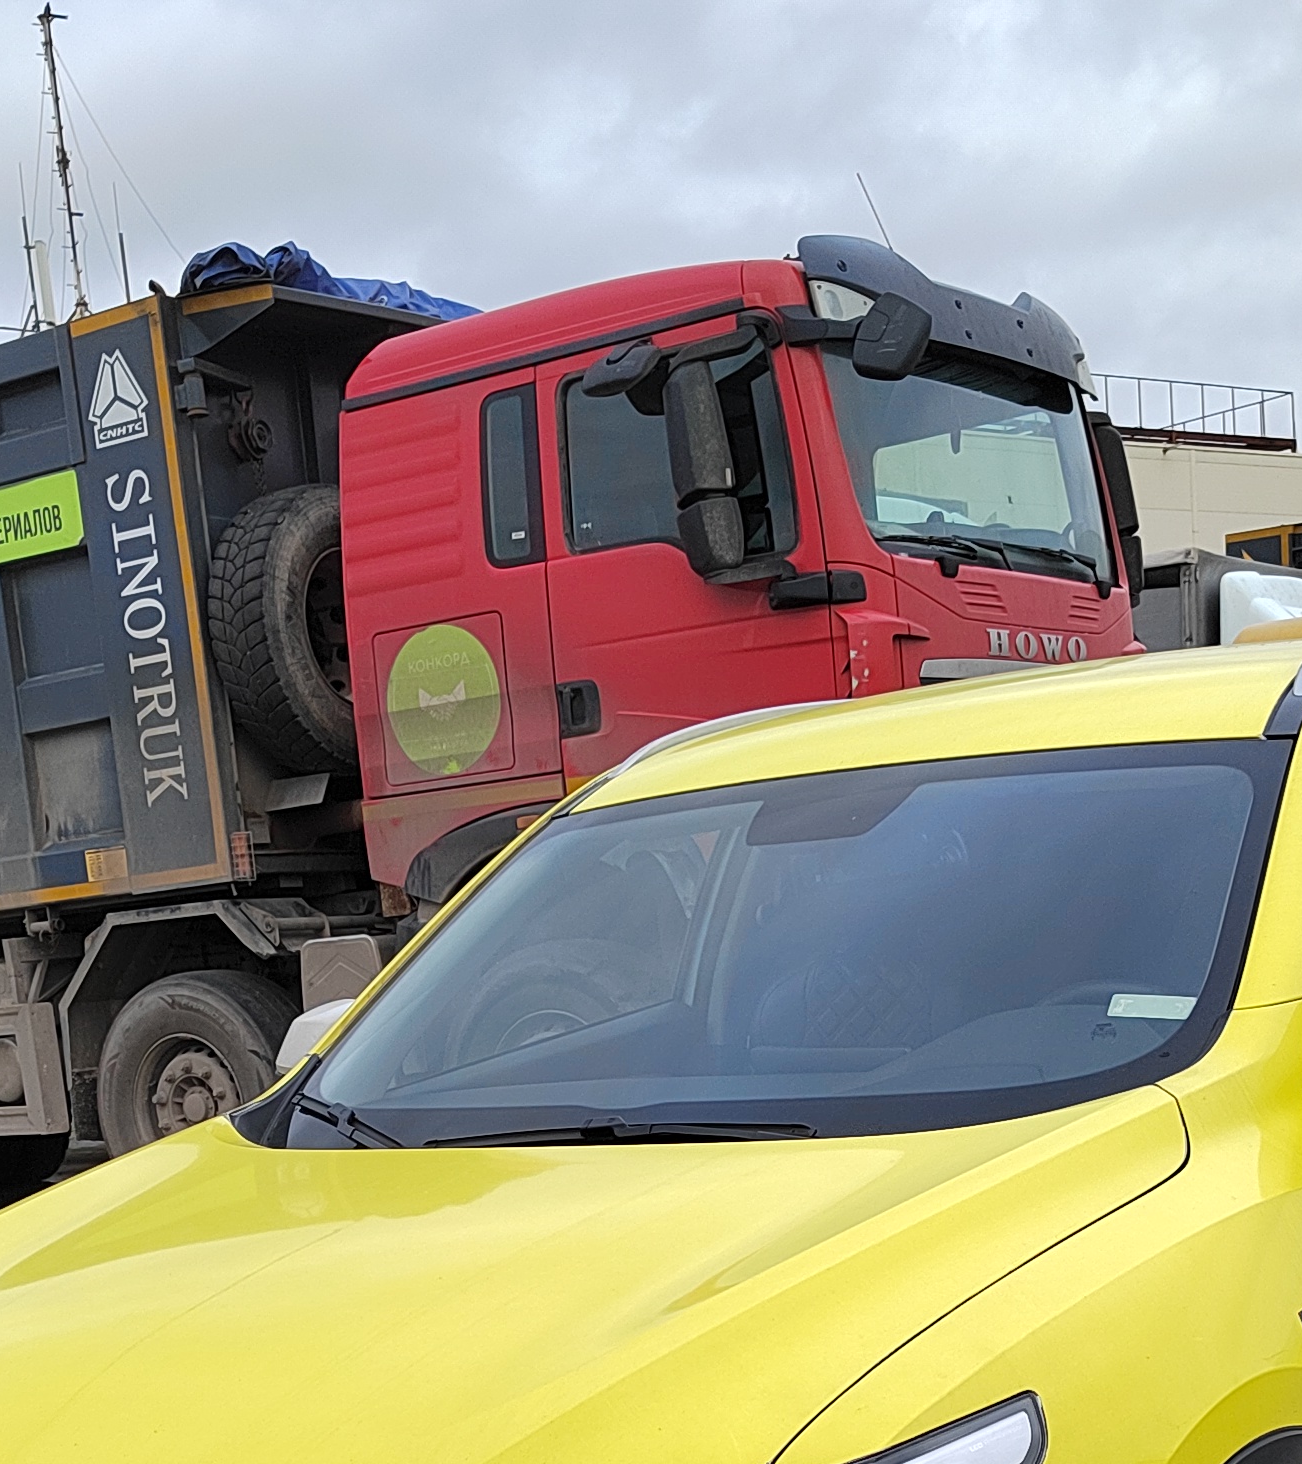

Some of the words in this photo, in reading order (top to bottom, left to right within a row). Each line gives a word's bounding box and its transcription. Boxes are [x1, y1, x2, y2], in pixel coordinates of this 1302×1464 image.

[99, 421, 142, 440] CNHTC
[104, 468, 188, 808] SINOTRUK
[986, 628, 1088, 662] HOWO
[407, 651, 471, 674] КОНКОРД
